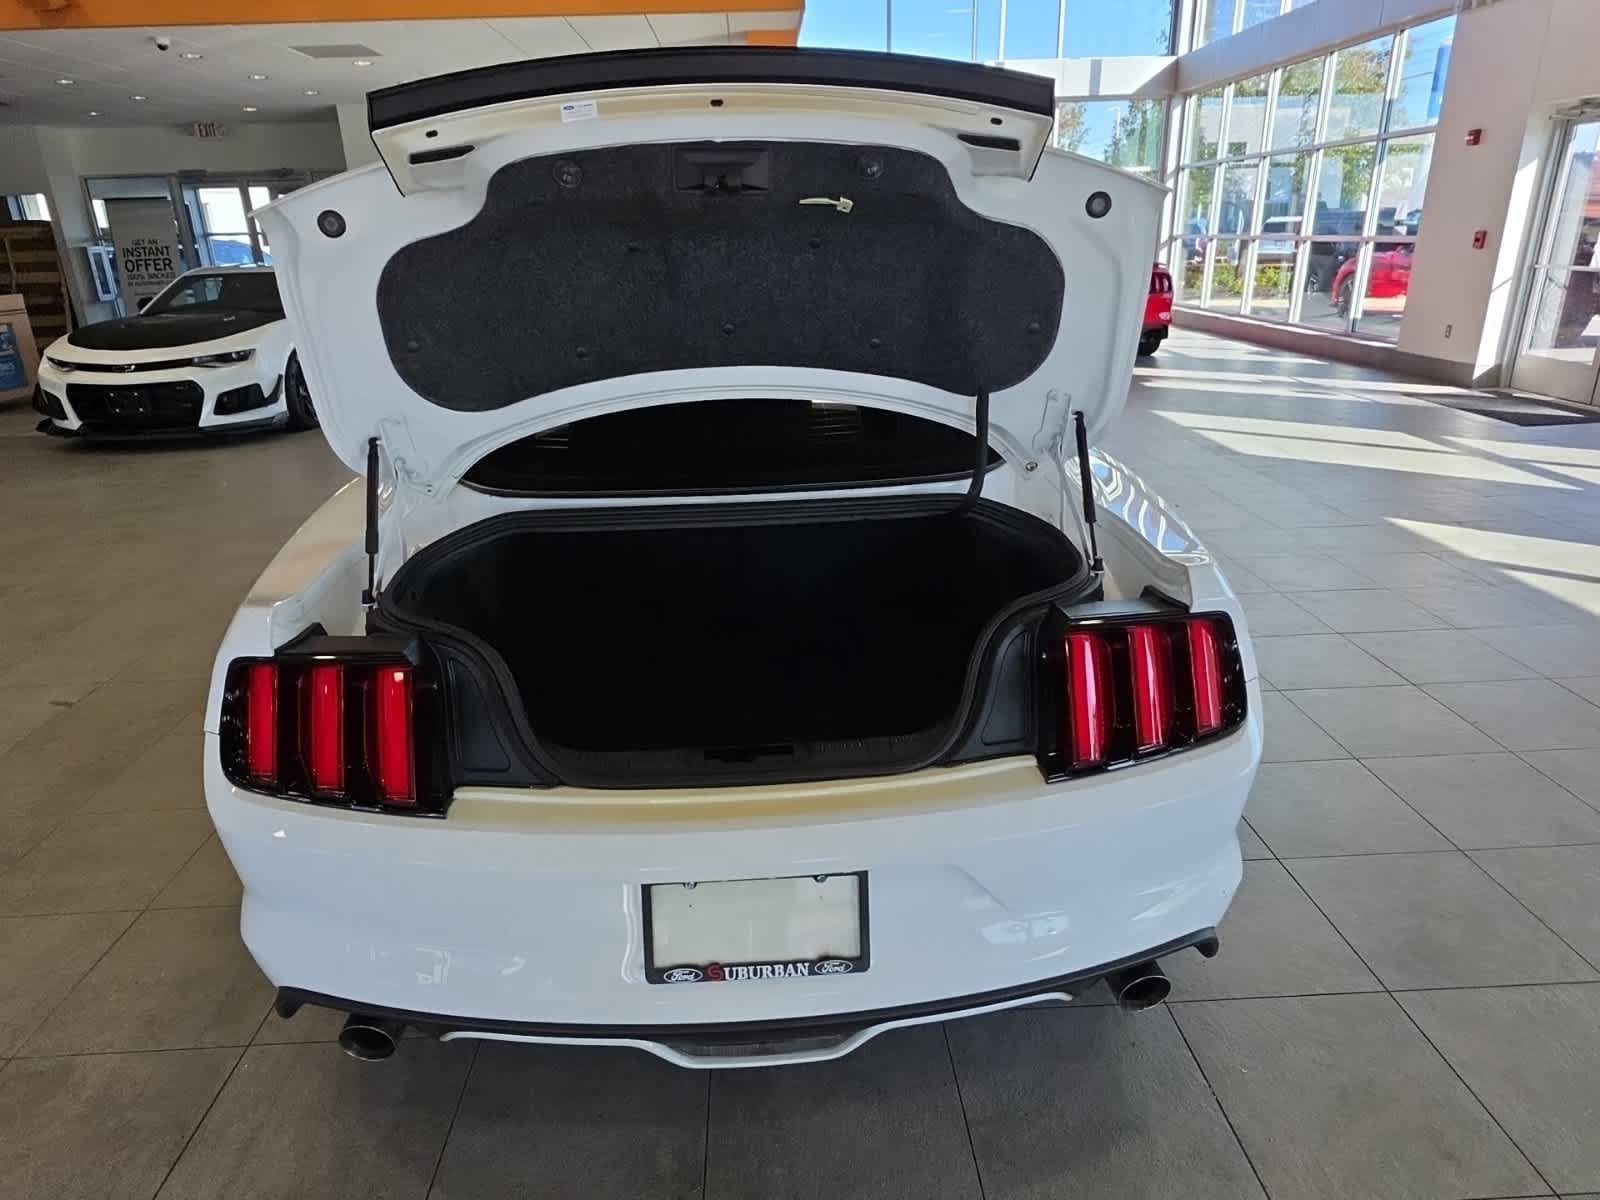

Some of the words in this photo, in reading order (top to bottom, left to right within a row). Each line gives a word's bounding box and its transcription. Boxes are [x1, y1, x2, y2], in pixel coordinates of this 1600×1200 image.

[198, 122, 216, 136] EXIT
[122, 246, 171, 258] INSTANT
[124, 258, 174, 272] OFFER
[669, 969, 699, 982] Ford
[707, 962, 810, 981] SUBURBAN
[819, 960, 849, 974] Ford
